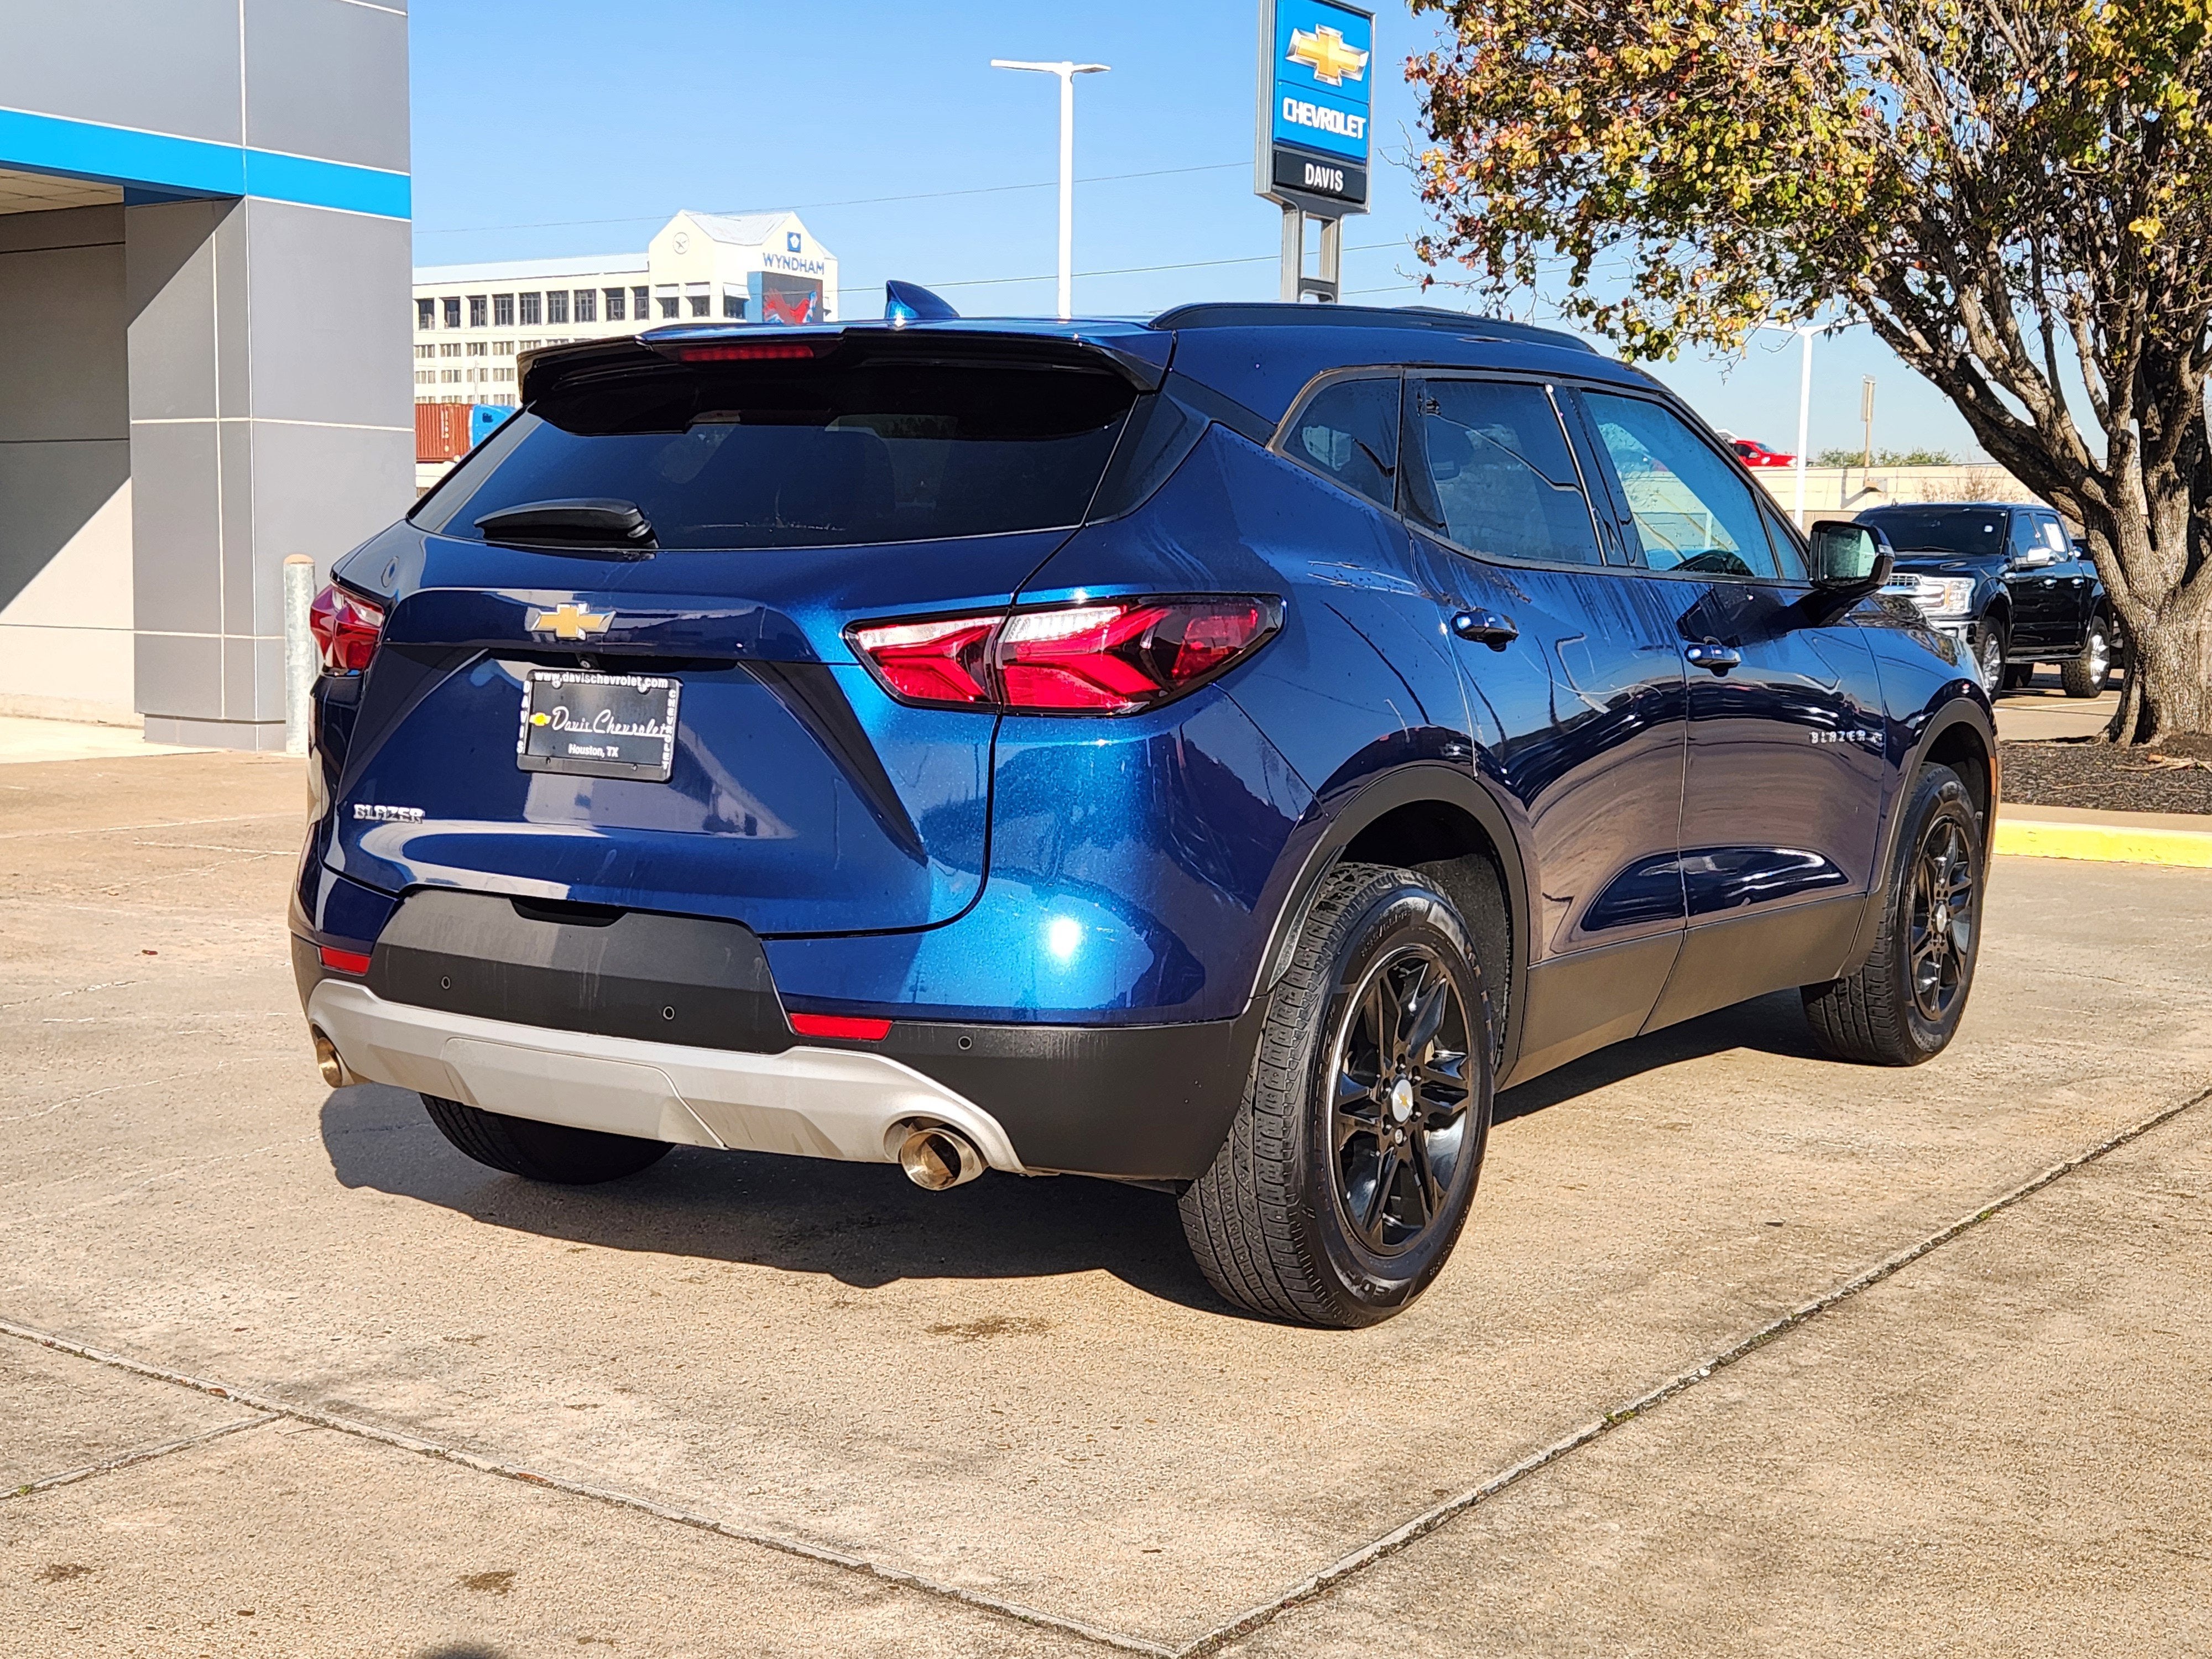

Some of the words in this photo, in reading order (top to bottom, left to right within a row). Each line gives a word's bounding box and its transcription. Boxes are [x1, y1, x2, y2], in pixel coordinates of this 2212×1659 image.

[1283, 97, 1366, 139] CHEVROLET
[1305, 163, 1344, 192] DAVIS
[763, 252, 825, 275] WYNDHAM
[535, 671, 668, 688] www.davischevrolet.com
[517, 680, 530, 754] DAVIS
[552, 706, 592, 732] Davis
[593, 709, 666, 737] Chevrolet
[1811, 729, 1866, 744] BLAZER
[568, 743, 605, 758] Houston,
[607, 745, 619, 757] TX
[353, 804, 425, 824] BLAZER
